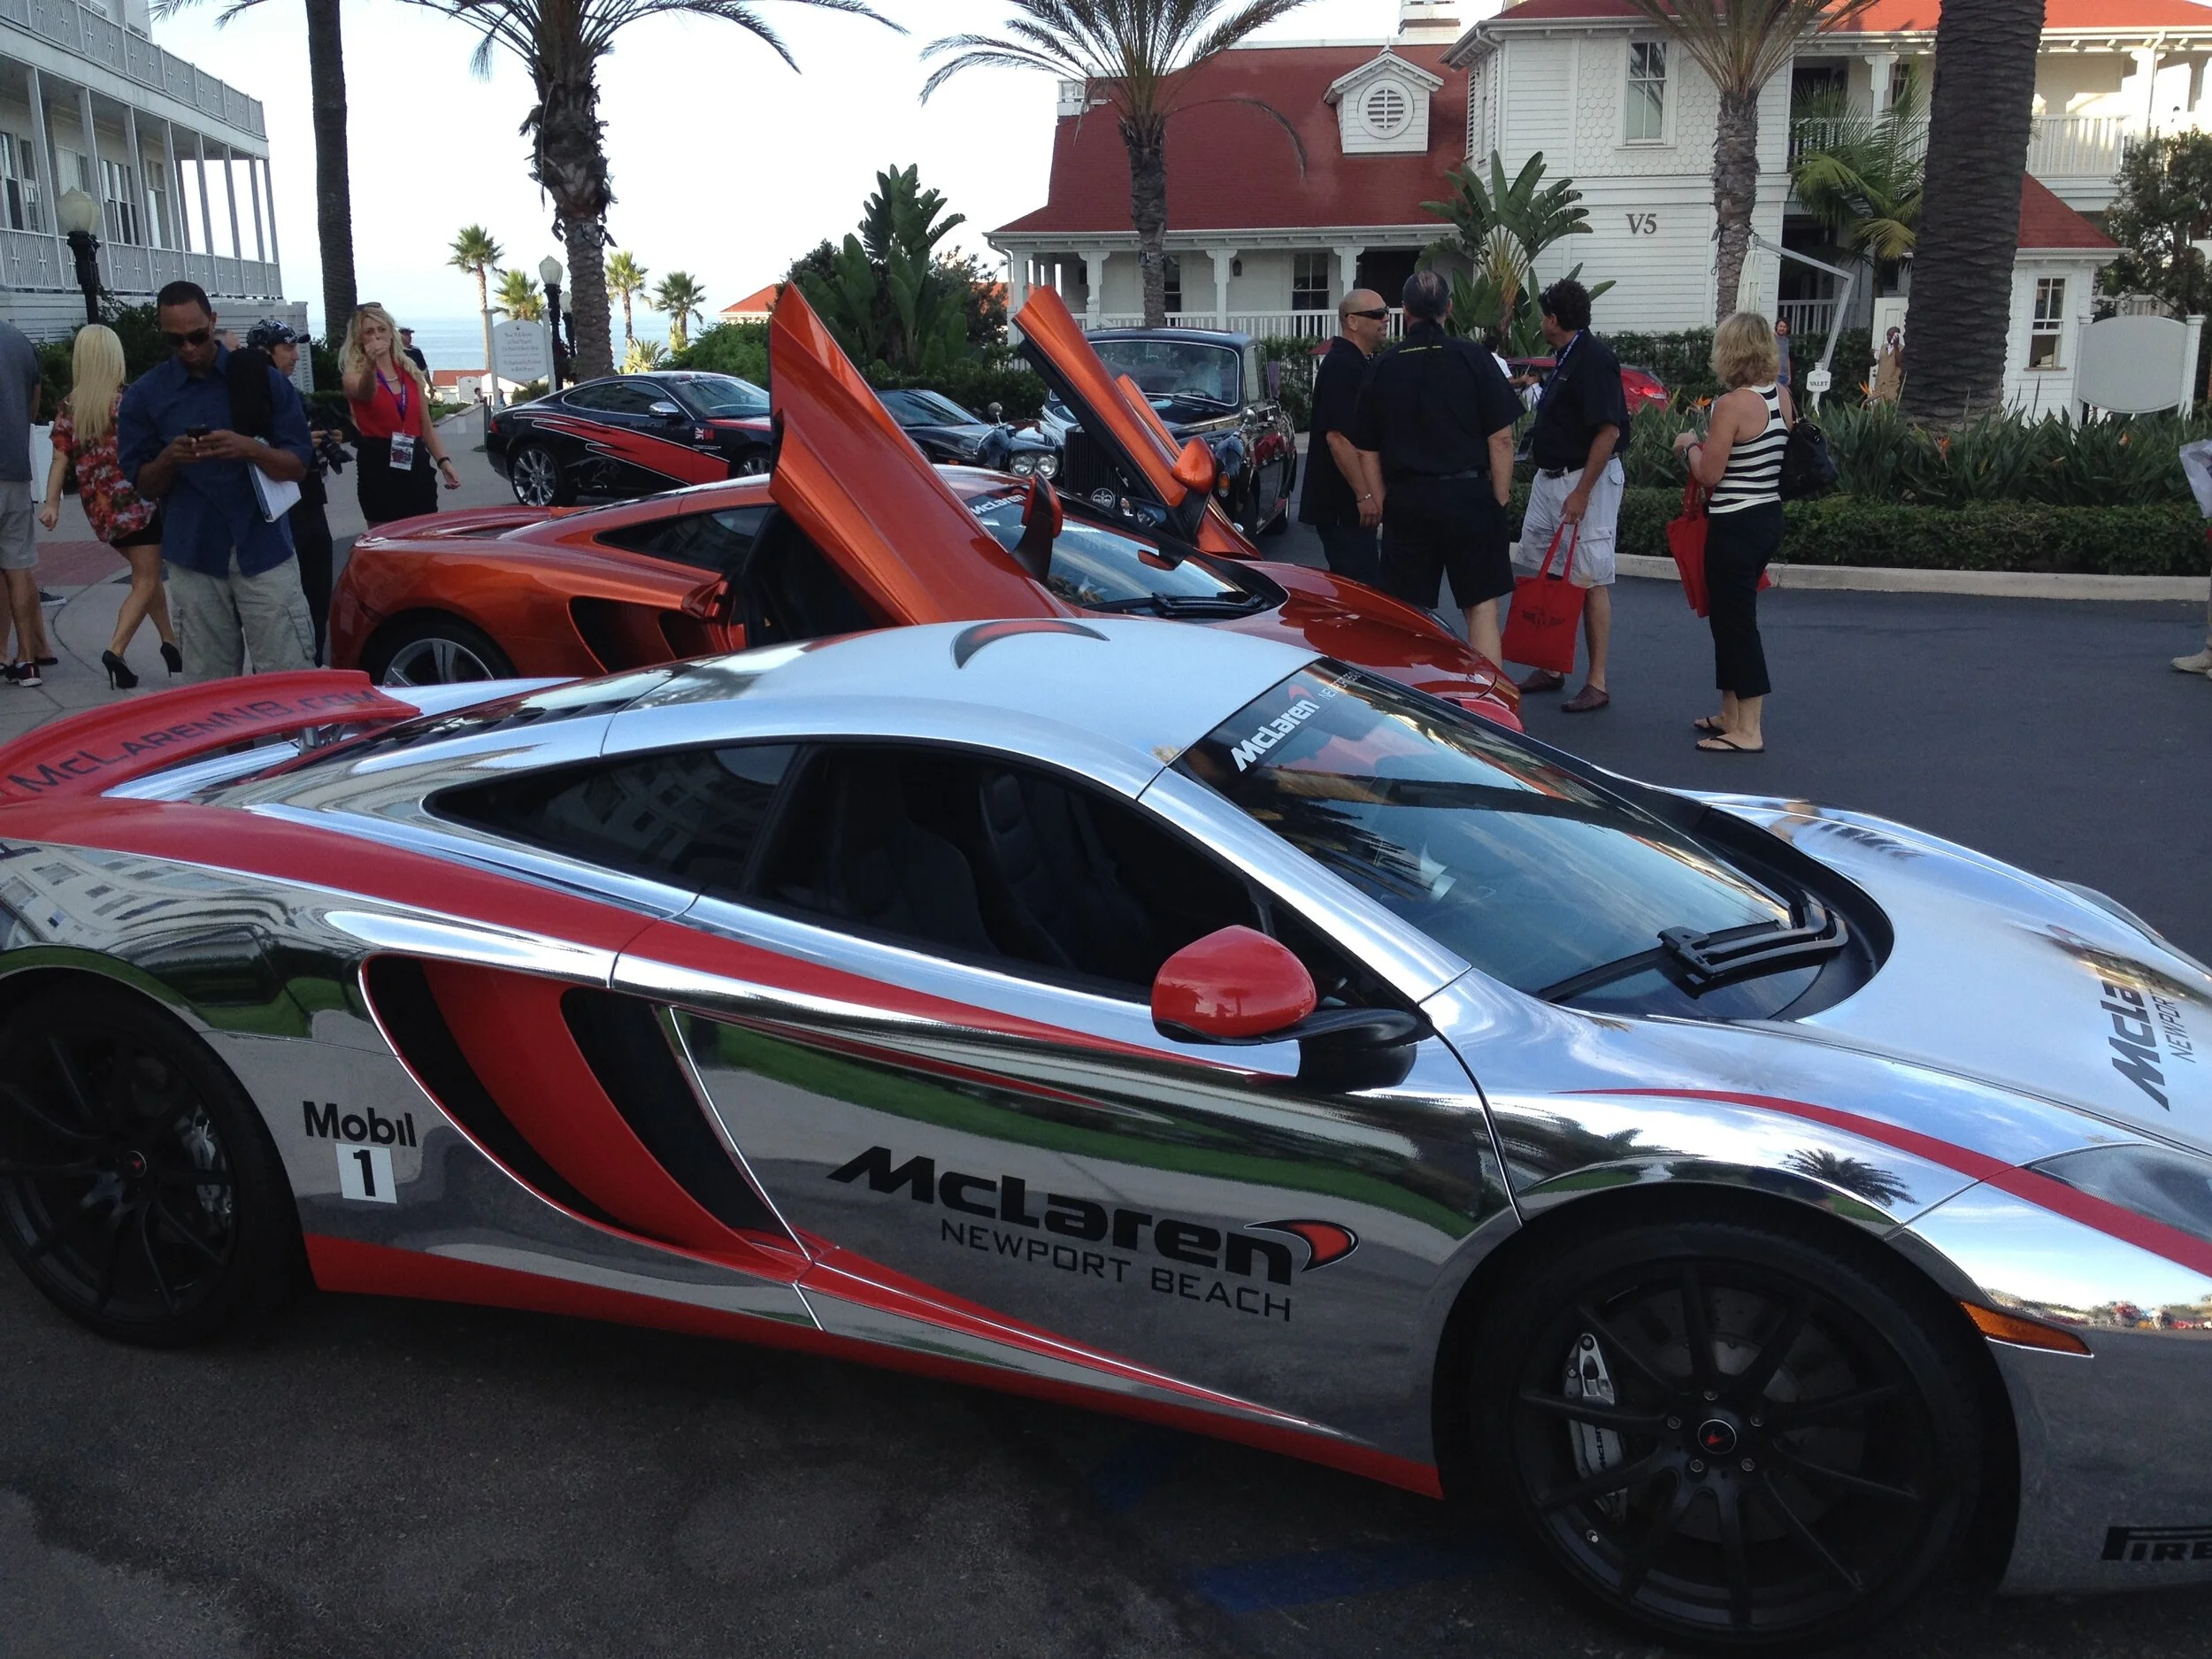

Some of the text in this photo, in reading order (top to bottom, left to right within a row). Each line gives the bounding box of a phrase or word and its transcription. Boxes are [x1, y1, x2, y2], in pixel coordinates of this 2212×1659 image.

[1625, 213, 1656, 234] V5
[971, 494, 1026, 515] McLaren
[1231, 699, 1320, 772] McLaren
[2100, 979, 2170, 1113] McLa
[303, 1101, 417, 1148] Mobil
[352, 1148, 376, 1197] 1
[826, 1146, 1292, 1286] McLaren
[941, 1218, 1292, 1322] NEWPORT BEACH
[1595, 1425, 1607, 1470] McLar
